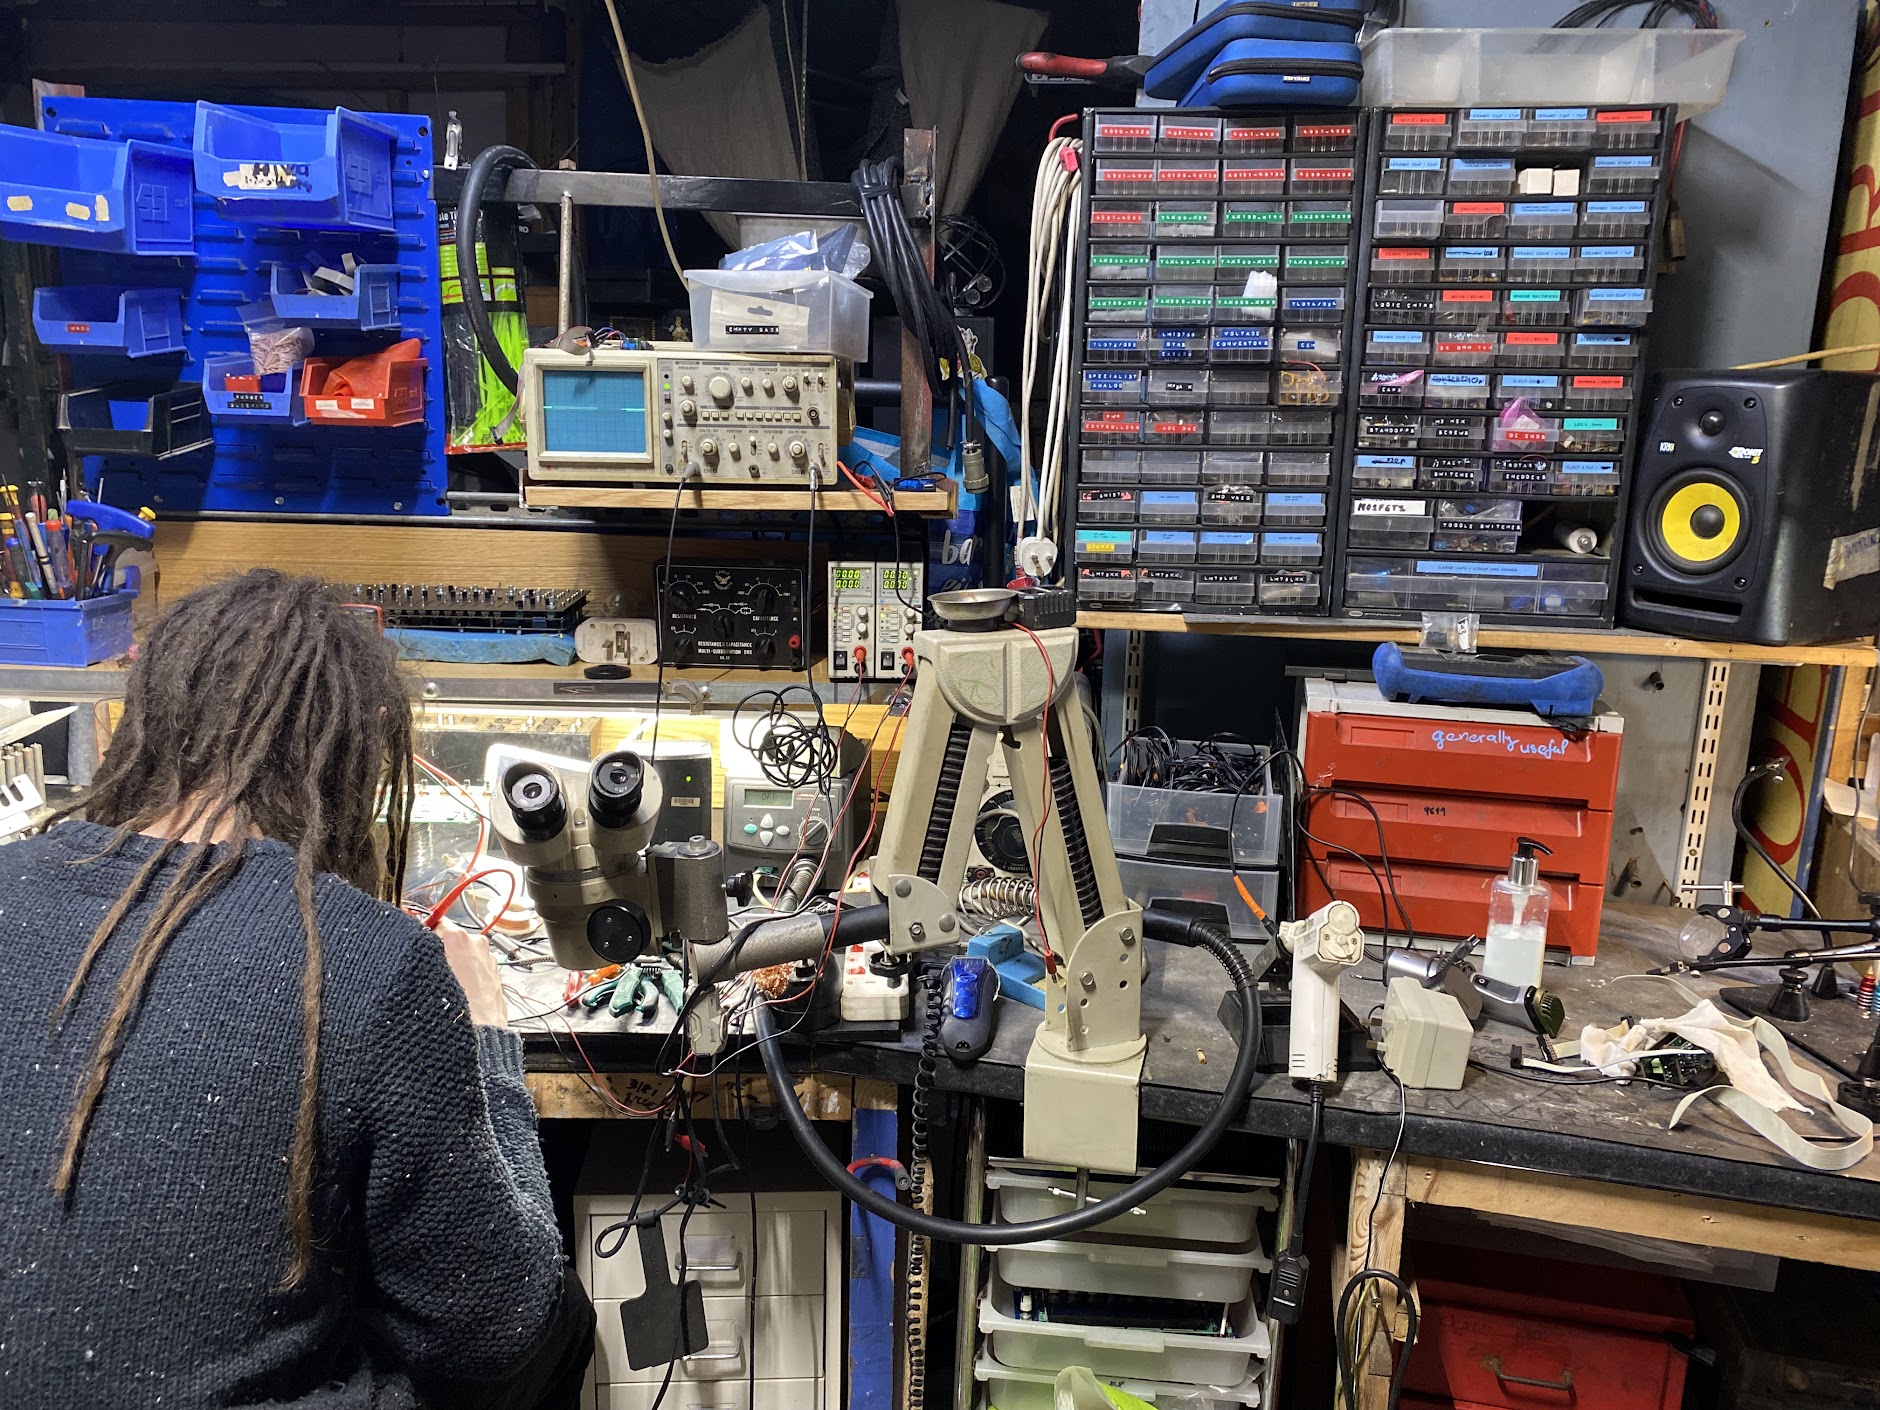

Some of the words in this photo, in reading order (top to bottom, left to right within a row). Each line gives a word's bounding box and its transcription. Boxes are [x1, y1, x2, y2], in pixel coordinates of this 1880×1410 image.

[1358, 502, 1406, 512] MOSFETS
[1442, 522, 1473, 530] TOGGLE
[1432, 729, 1519, 752] generally
[1520, 738, 1569, 759] useful
